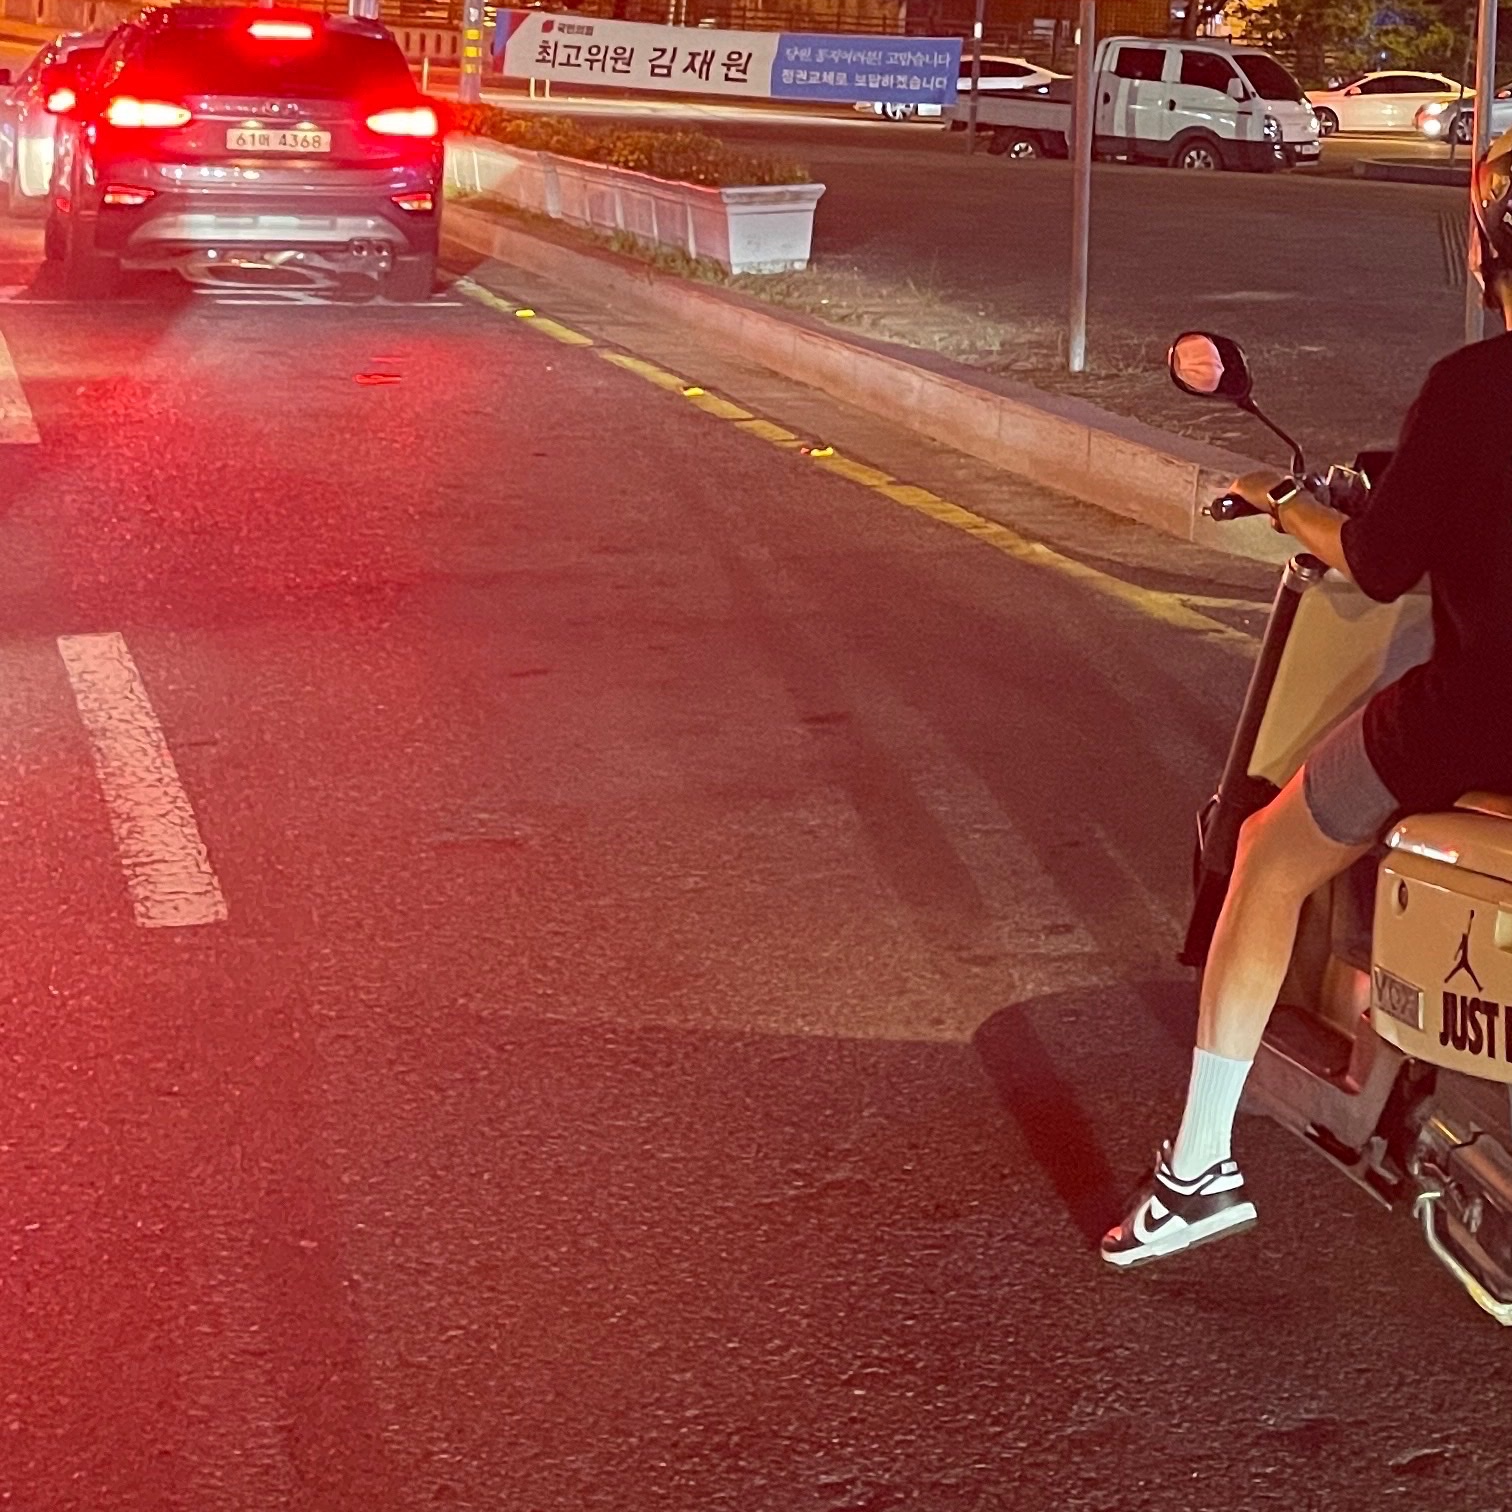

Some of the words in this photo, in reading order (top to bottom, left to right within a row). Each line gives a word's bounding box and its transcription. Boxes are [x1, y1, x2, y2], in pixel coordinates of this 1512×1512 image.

[535, 40, 635, 75] 최고위원
[279, 133, 322, 148] 4368
[1439, 991, 1499, 1059] JUST
